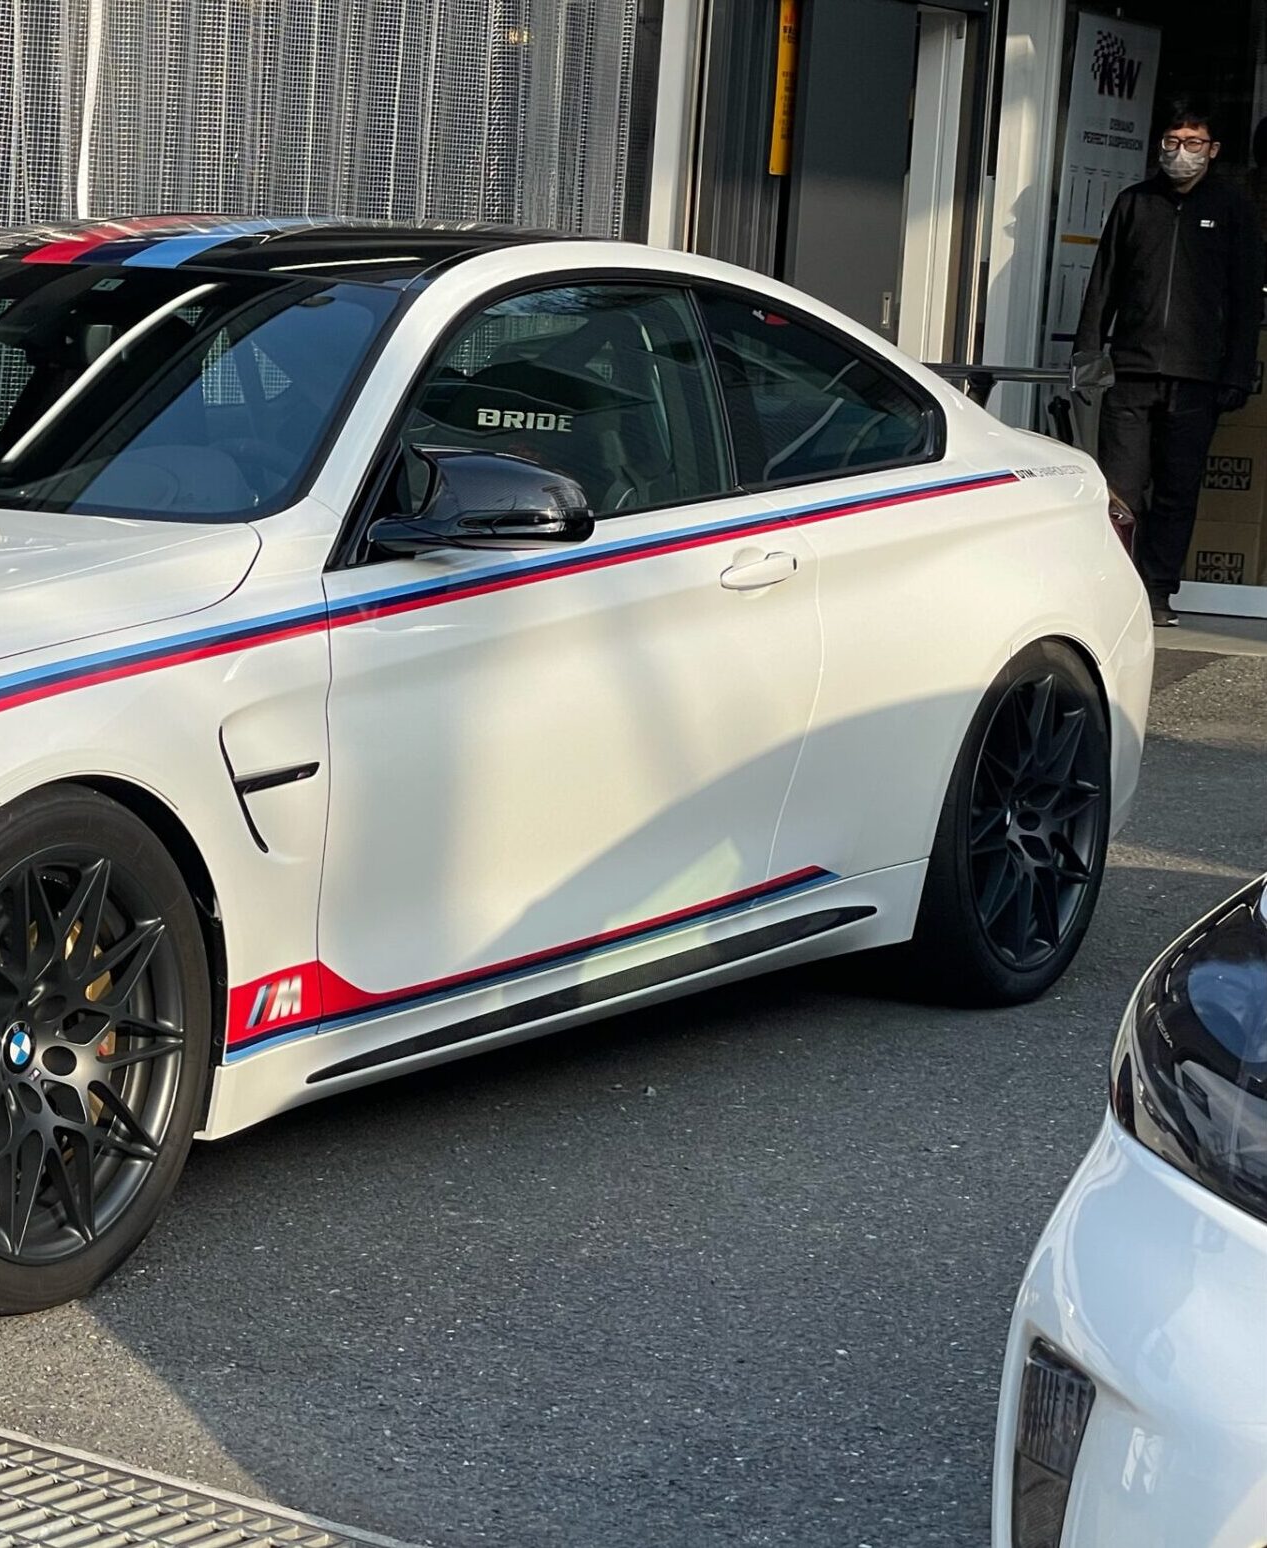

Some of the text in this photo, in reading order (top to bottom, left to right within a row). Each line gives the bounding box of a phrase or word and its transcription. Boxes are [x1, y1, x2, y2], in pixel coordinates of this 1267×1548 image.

[477, 408, 573, 432] BRIDE
[1207, 458, 1250, 473] LIQUI
[1204, 474, 1249, 489] MOLY
[1198, 552, 1243, 567] LIQUI
[1197, 568, 1242, 583] MOLY
